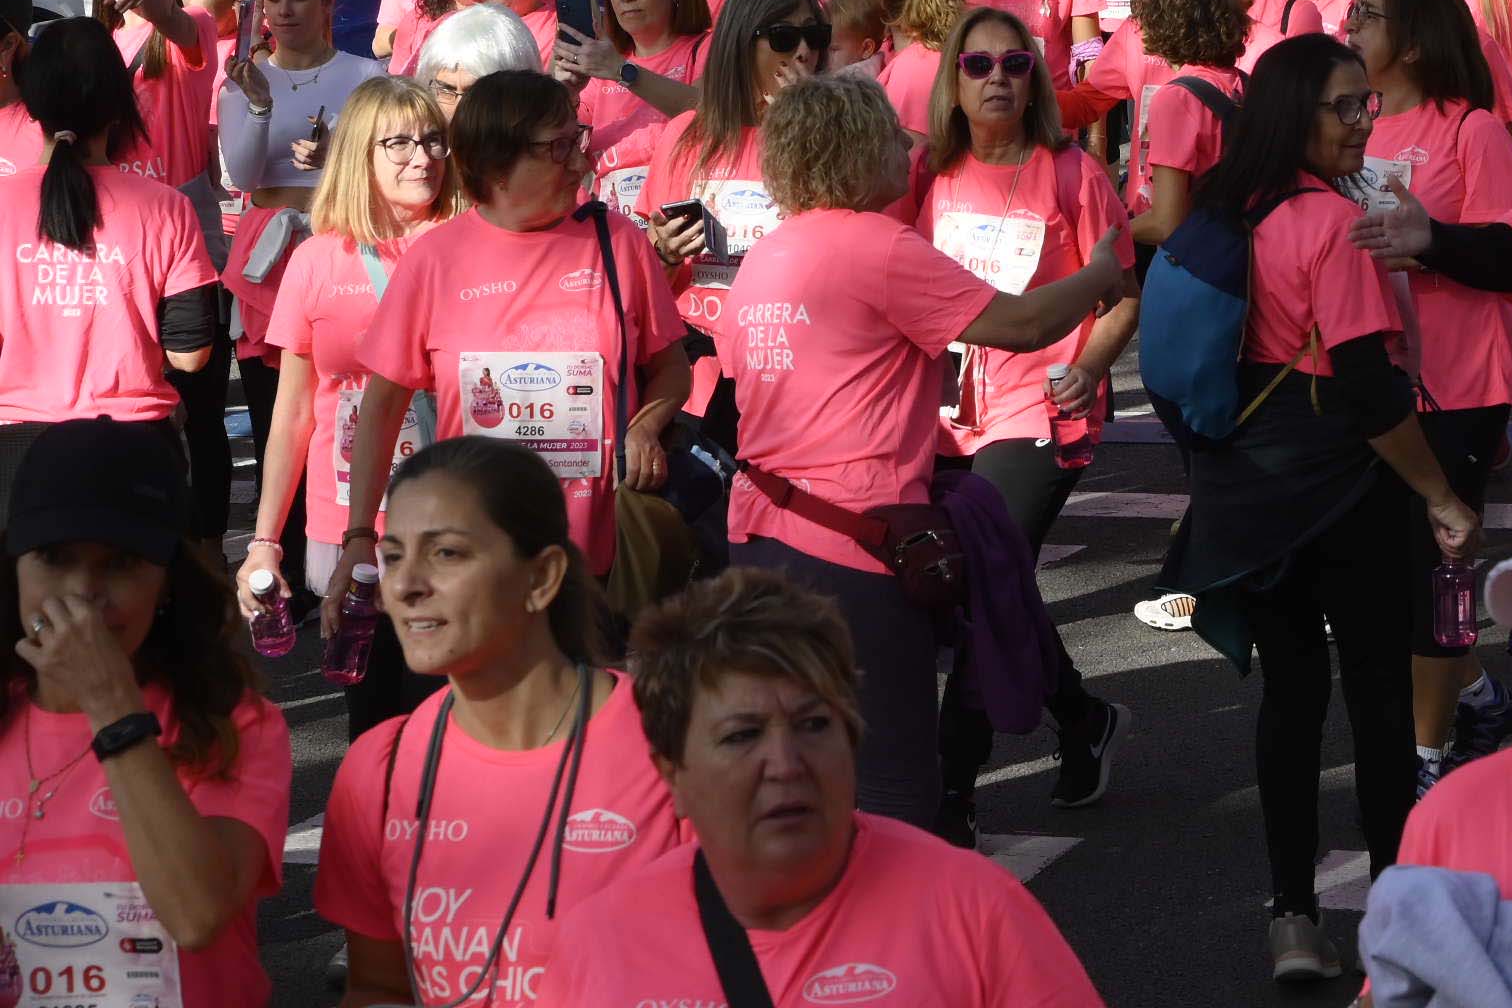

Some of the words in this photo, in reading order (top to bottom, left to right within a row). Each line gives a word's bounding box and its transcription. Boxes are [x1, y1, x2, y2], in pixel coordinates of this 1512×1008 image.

[37, 264, 68, 284] DE
[77, 264, 104, 284] LA
[31, 285, 109, 306] MUJER
[459, 279, 518, 301] OYSHO
[737, 301, 811, 327] CARRERA
[747, 326, 766, 348] DE
[766, 325, 790, 347] LA
[746, 347, 796, 371] MUJER
[504, 373, 558, 386] ASTURIANA
[566, 369, 594, 377] SUMA
[508, 401, 555, 421] 016
[515, 425, 546, 437] 4286
[539, 442, 568, 450] MUJER
[549, 459, 591, 469] Santander
[385, 818, 469, 842] OYHO
[22, 920, 103, 938] ASTURIANA
[29, 964, 108, 996] 016
[810, 979, 890, 998] ASTURIANA
